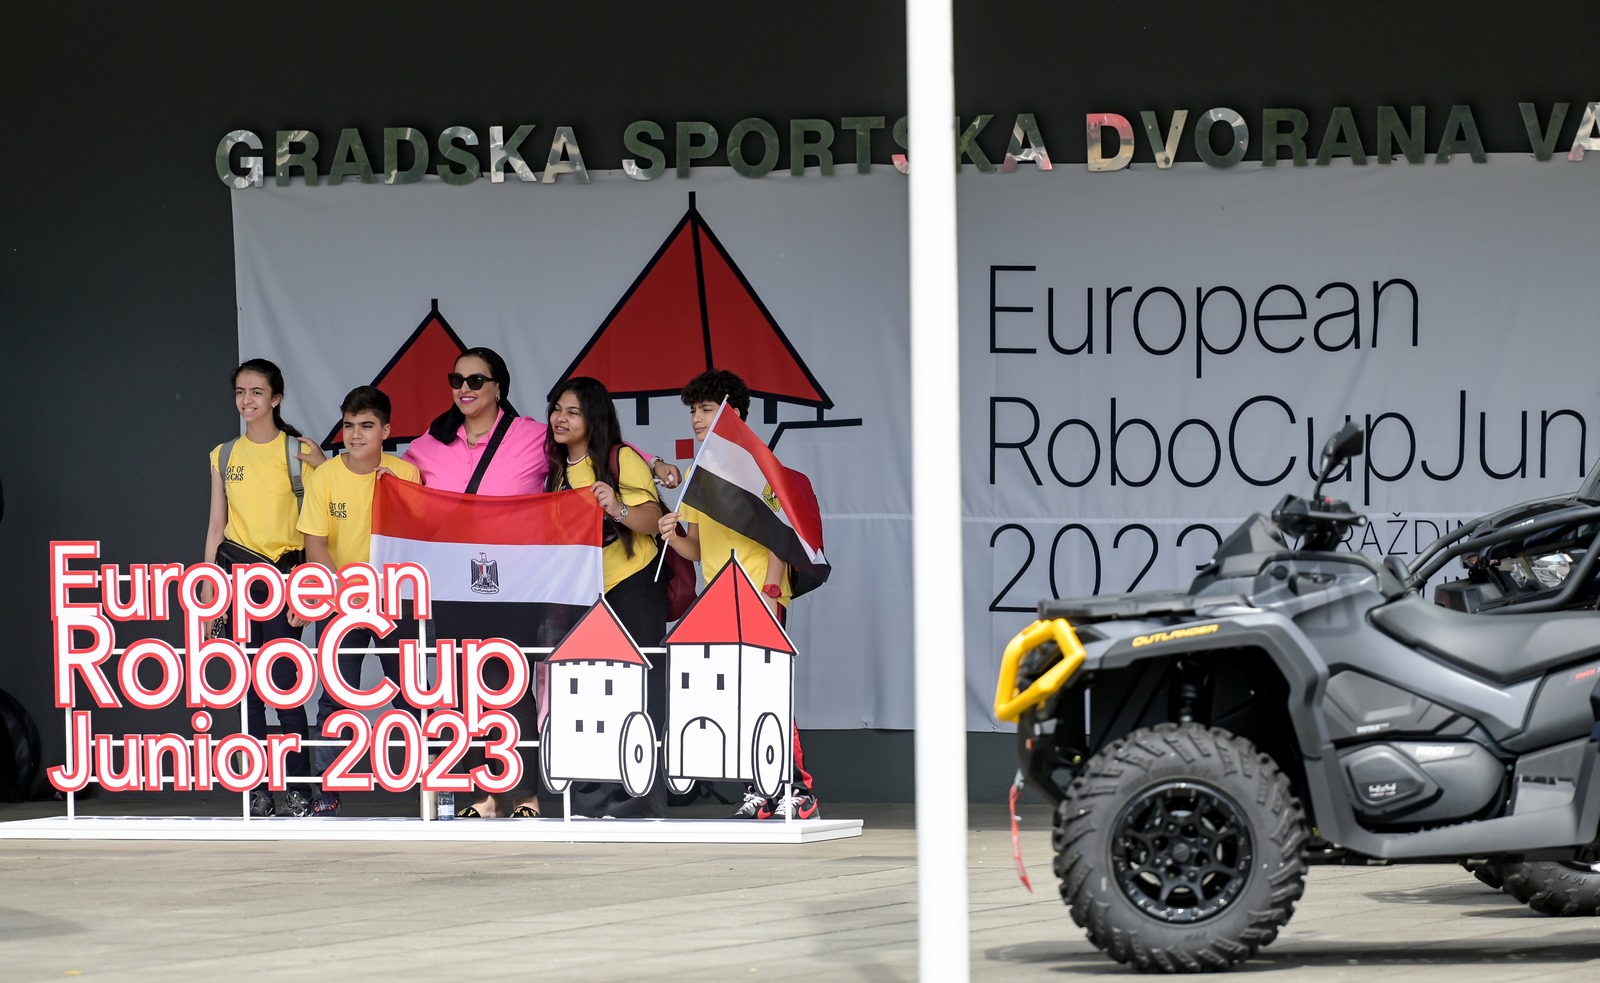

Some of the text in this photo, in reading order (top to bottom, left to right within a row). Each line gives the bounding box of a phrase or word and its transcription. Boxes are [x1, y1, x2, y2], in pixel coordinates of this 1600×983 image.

[215, 124, 591, 189] GRADSKA
[1086, 104, 1487, 172] DVORANA
[989, 264, 1420, 379] European
[49, 540, 431, 642] European
[1131, 623, 1219, 648] OUTLANDER
[54, 609, 530, 737] RoboCup
[47, 709, 524, 793] Junior 2023
